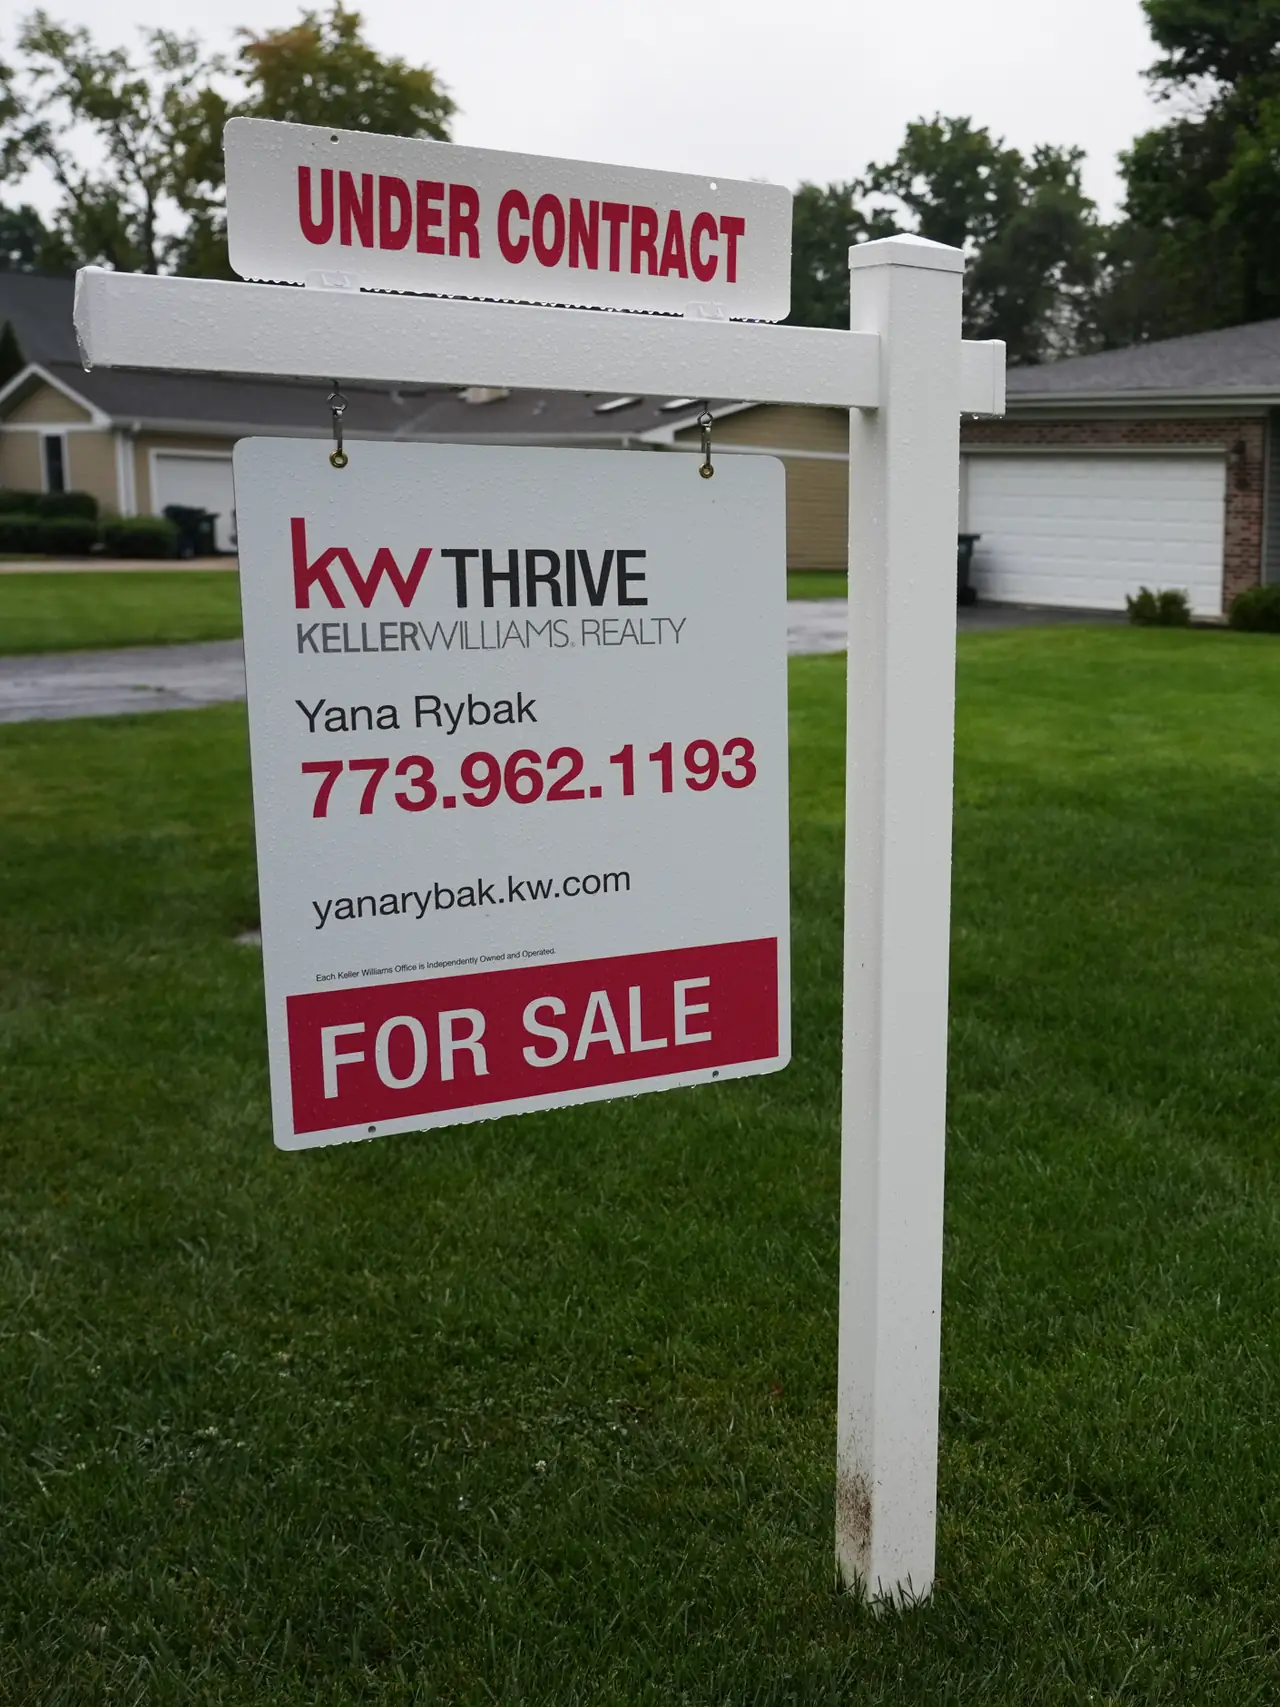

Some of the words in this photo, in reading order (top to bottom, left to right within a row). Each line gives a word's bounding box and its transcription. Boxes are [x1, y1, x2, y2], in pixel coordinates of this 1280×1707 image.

[297, 165, 481, 259] UNDER
[497, 188, 746, 284] CONTRACT
[290, 517, 433, 609] kw
[440, 548, 649, 609] THRIVE
[581, 617, 687, 647] REALTY
[295, 699, 401, 734] Yana
[414, 691, 538, 736] Rybak
[301, 737, 757, 819] 773.962.1193
[312, 870, 631, 929] yanarybak.kw.com
[315, 973, 336, 982] Each
[337, 970, 360, 980] Keller
[361, 966, 393, 977] Williams
[394, 964, 417, 973] Office
[418, 962, 425, 970] is
[426, 956, 478, 969] Independently
[479, 953, 506, 963] Owned
[506, 951, 521, 960] and
[521, 948, 556, 959] Operated.
[320, 1008, 490, 1100] FOR
[522, 976, 712, 1068] SALE
